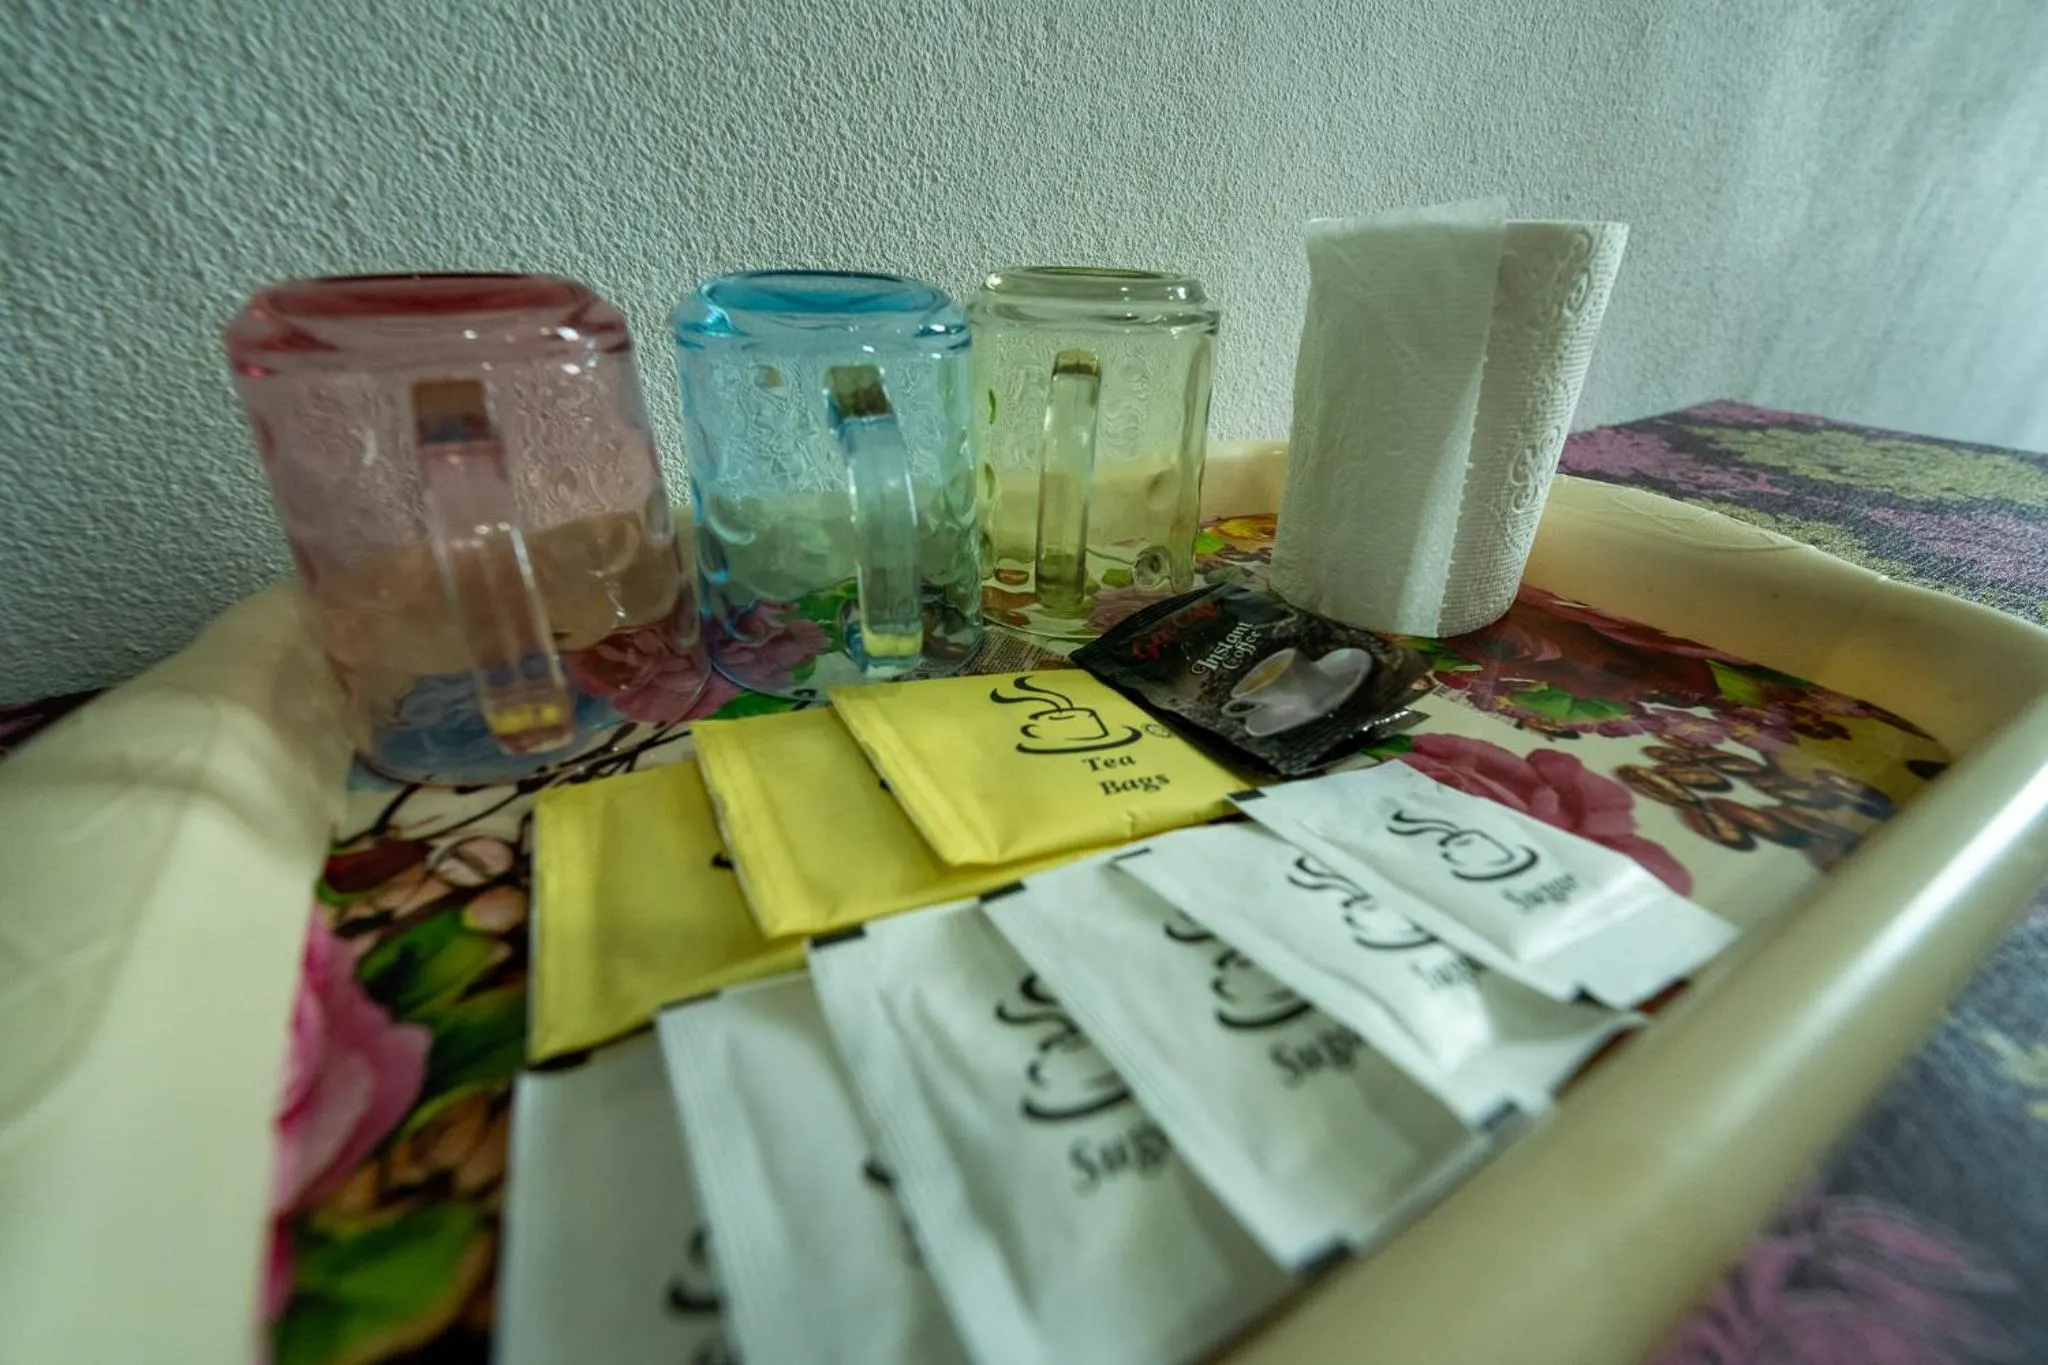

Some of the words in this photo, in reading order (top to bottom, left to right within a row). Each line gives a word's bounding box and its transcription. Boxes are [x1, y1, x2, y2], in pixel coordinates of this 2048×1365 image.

[1191, 621, 1253, 673] Instant
[1220, 631, 1261, 670] Coffee
[1081, 755, 1136, 772] Tea
[1099, 774, 1170, 795] Bags
[1501, 872, 1578, 914] Sugar
